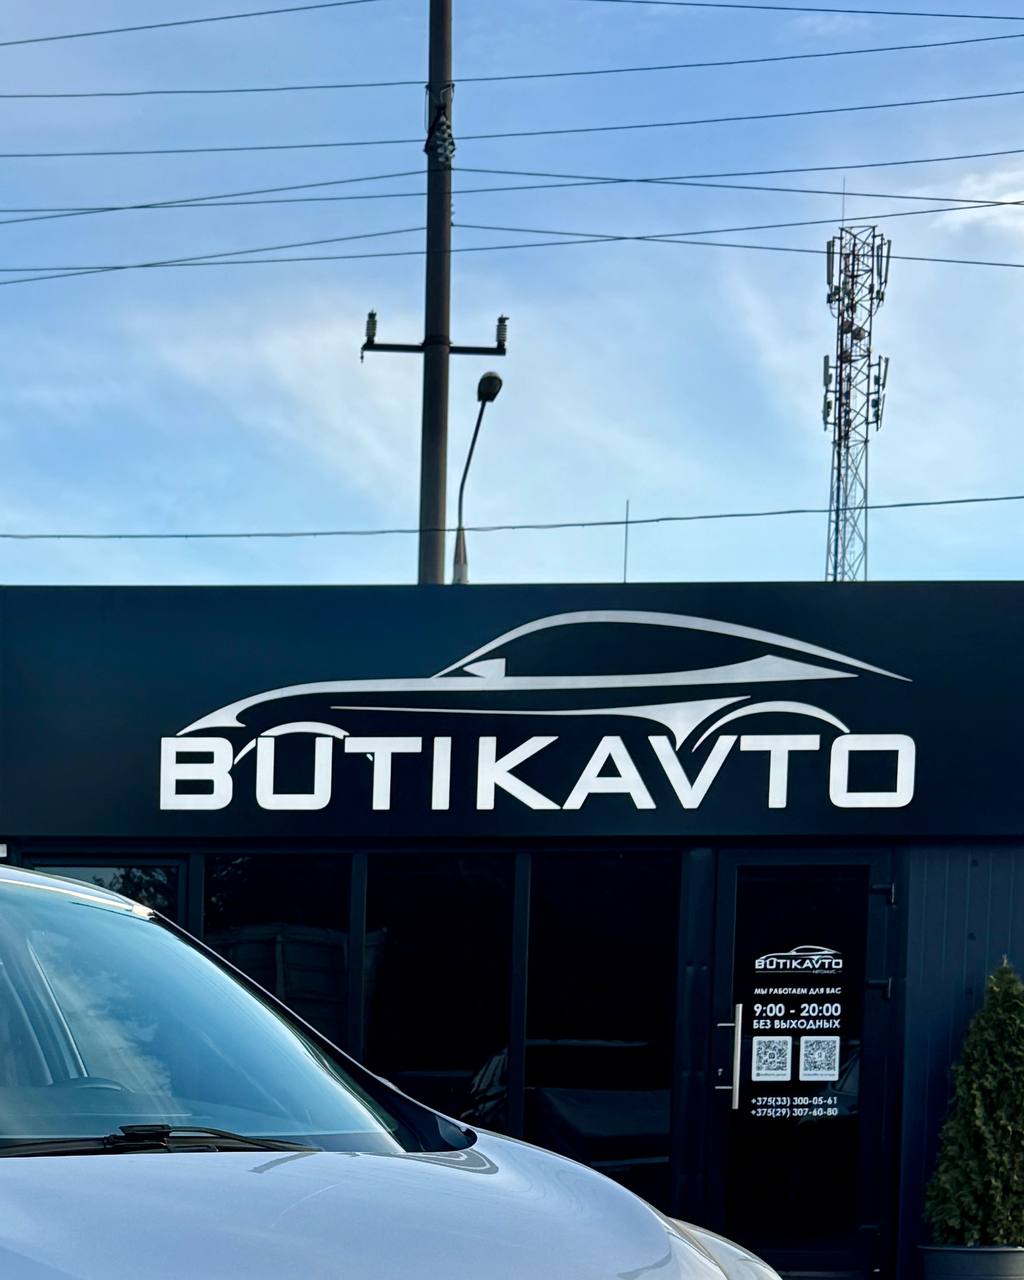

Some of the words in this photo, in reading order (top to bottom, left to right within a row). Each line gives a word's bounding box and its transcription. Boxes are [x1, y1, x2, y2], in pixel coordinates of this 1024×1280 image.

[159, 732, 917, 812] BUTIKAVTO
[755, 959, 843, 969] BUTIKAVTO
[753, 987, 768, 995] МЫ
[769, 987, 808, 995] РАБОТАЕМ
[808, 987, 825, 996] ДЛЯ
[825, 987, 842, 995] ВАС
[753, 1003, 785, 1017] 9:00
[800, 1003, 842, 1017] 20:00
[753, 1019, 772, 1029] БЕЗ
[774, 1019, 841, 1030] ВЫХОДНЫХ
[751, 1097, 791, 1106] +375(33)
[792, 1096, 838, 1105] 300-05-61
[750, 1108, 791, 1118] +375(29)
